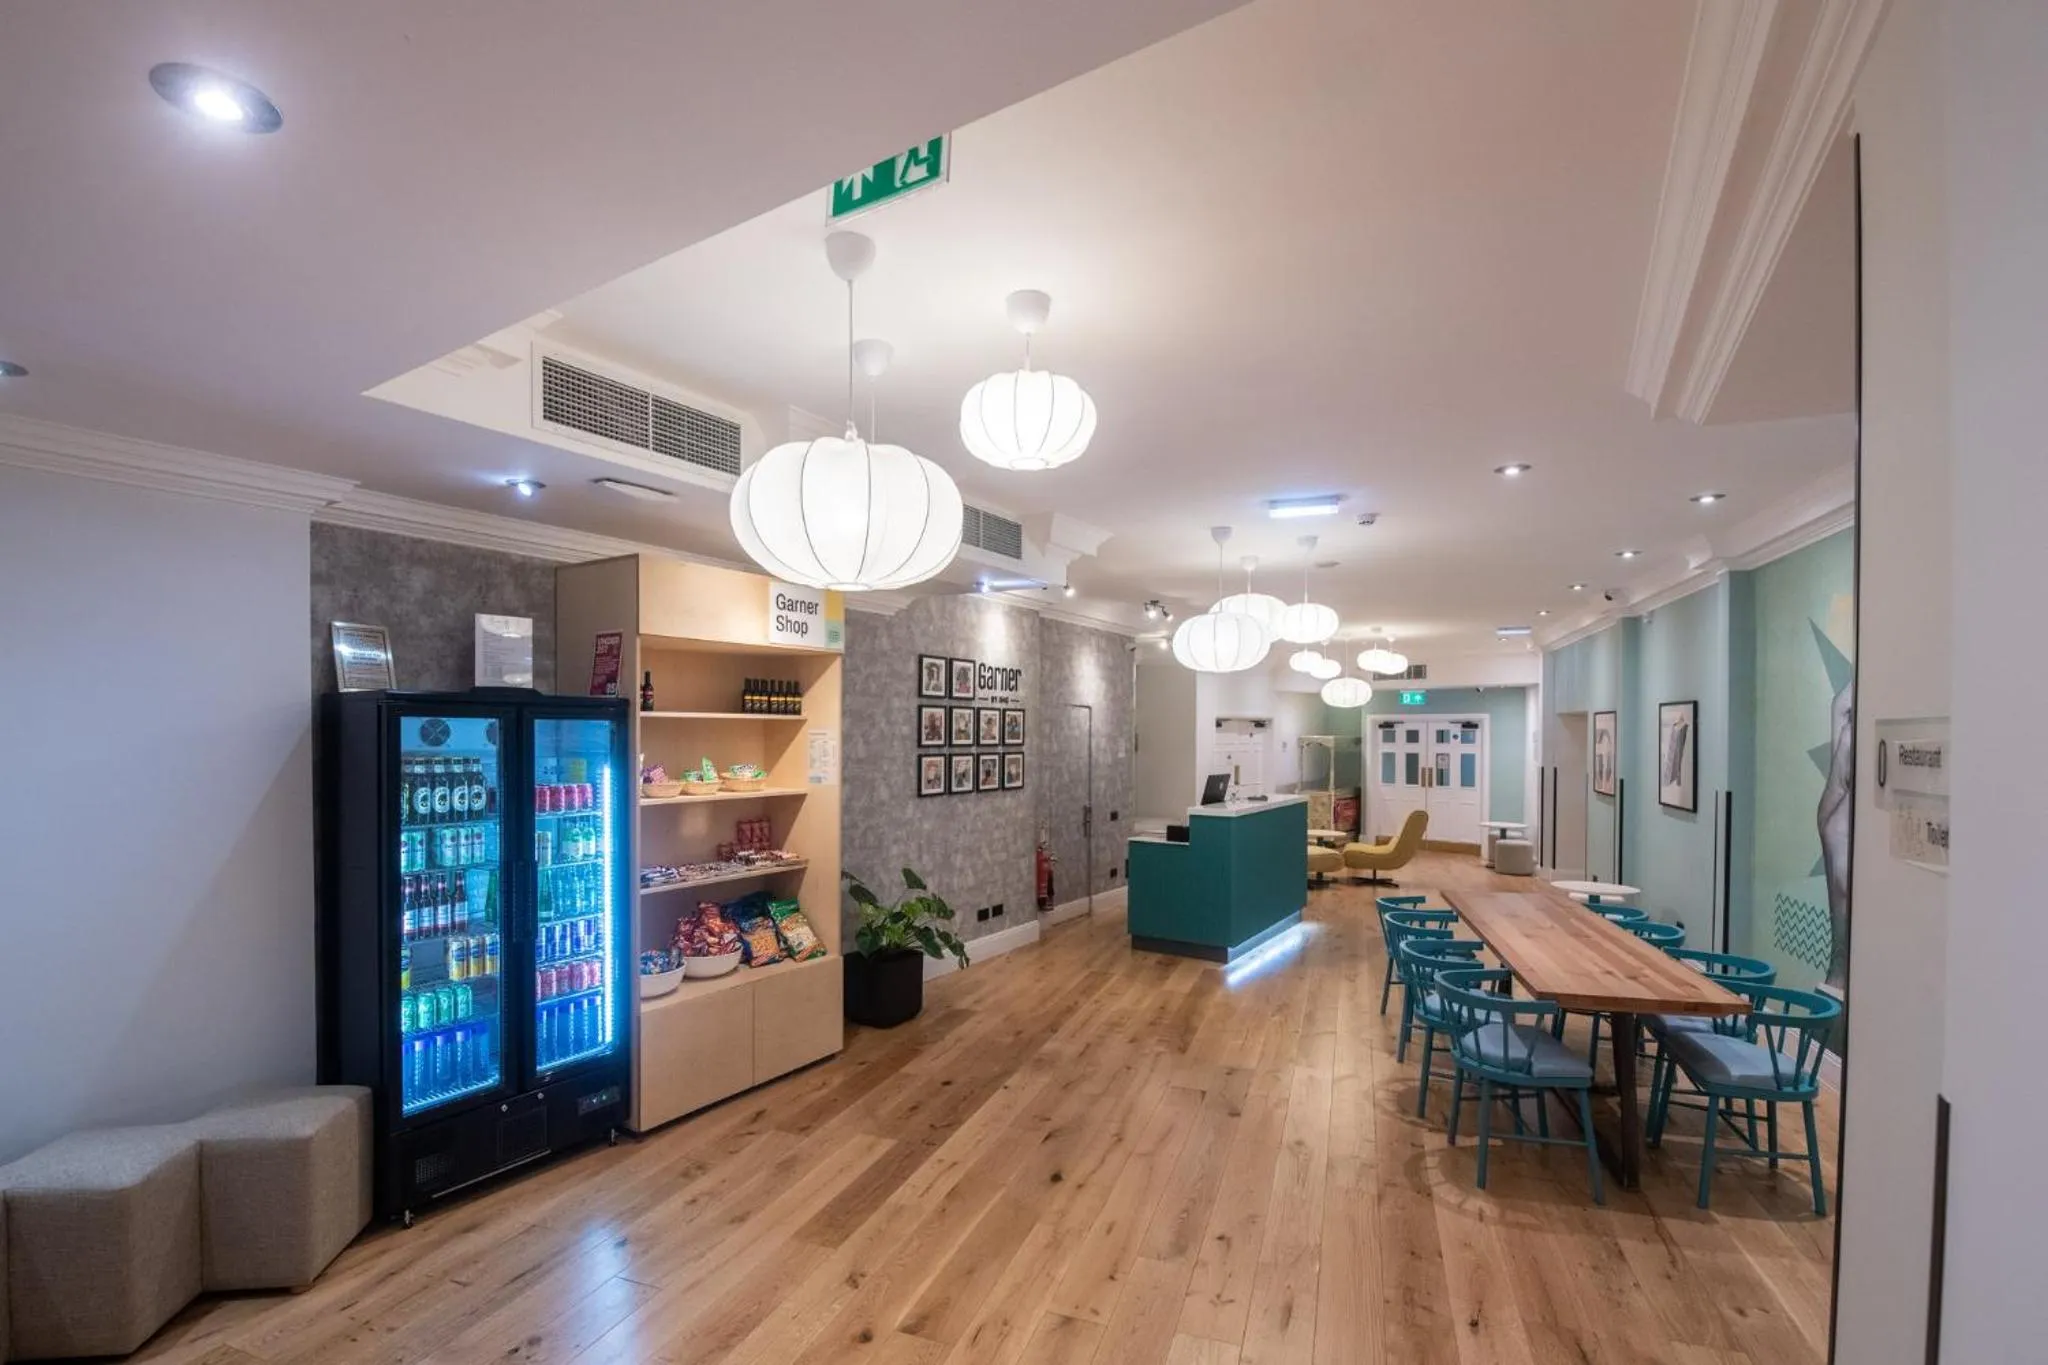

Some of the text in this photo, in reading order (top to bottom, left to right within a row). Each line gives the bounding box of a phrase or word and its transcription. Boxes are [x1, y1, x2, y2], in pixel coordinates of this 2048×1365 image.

[776, 593, 819, 615] Garner
[776, 614, 808, 638] Shop
[978, 661, 1022, 692] Garner
[1899, 744, 1942, 768] Restaurant
